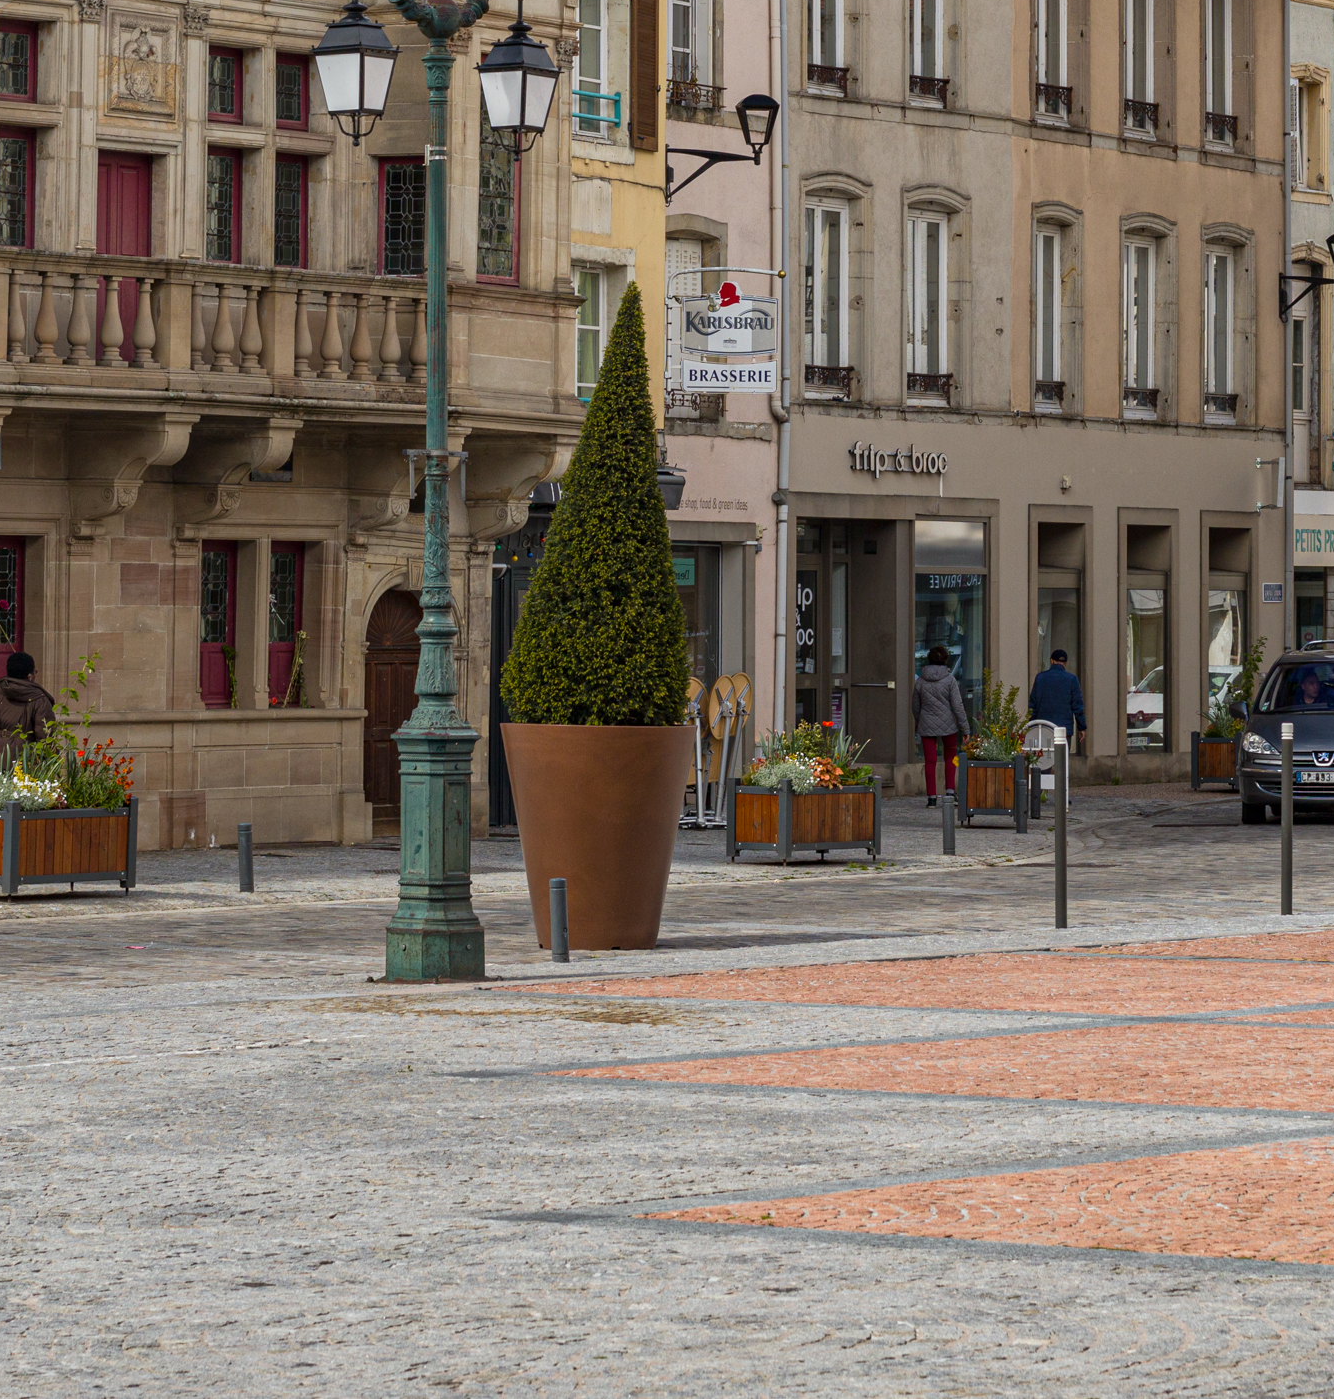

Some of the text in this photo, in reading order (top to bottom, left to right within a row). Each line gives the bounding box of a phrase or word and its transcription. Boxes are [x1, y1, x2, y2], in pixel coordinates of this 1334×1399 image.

[685, 311, 774, 336] KARLSBRÄU
[689, 369, 772, 383] BRASSERIE
[853, 441, 948, 479] frip & broc
[685, 497, 698, 511] shop,
[700, 497, 711, 510] food
[713, 497, 717, 510] &
[718, 500, 734, 513] green
[735, 499, 748, 511] ideas
[1295, 528, 1322, 553] PETITS
